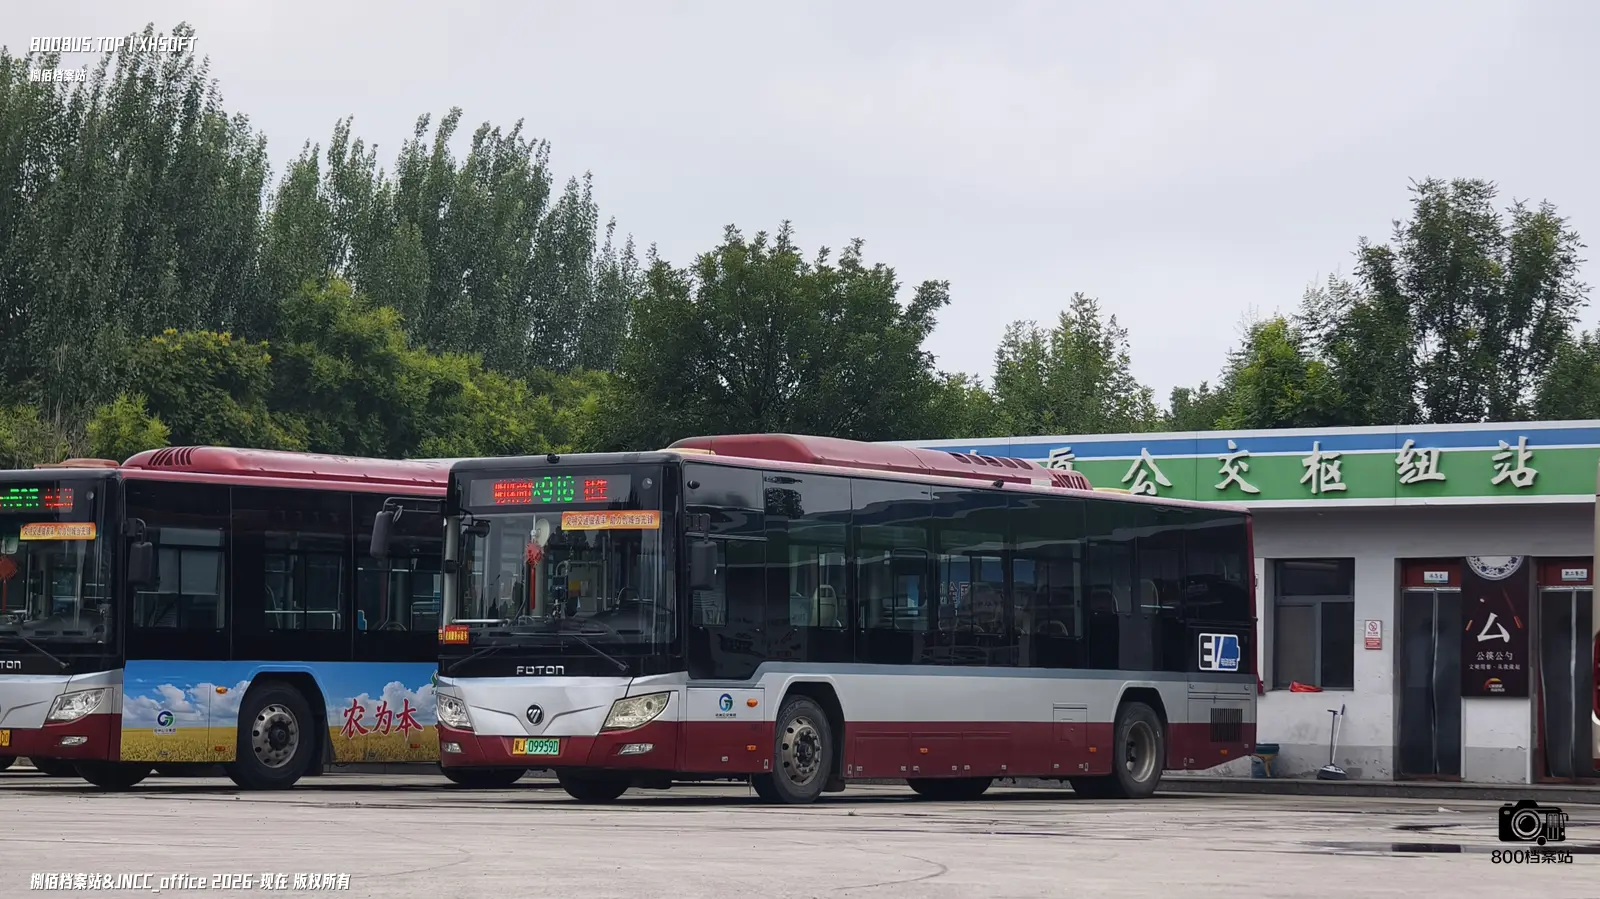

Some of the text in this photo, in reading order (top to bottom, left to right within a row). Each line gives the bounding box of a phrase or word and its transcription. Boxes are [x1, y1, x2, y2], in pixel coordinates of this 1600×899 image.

[969, 435, 1540, 496] 公交枢纽站
[516, 665, 565, 675] FOTON
[339, 698, 424, 740] 农为本
